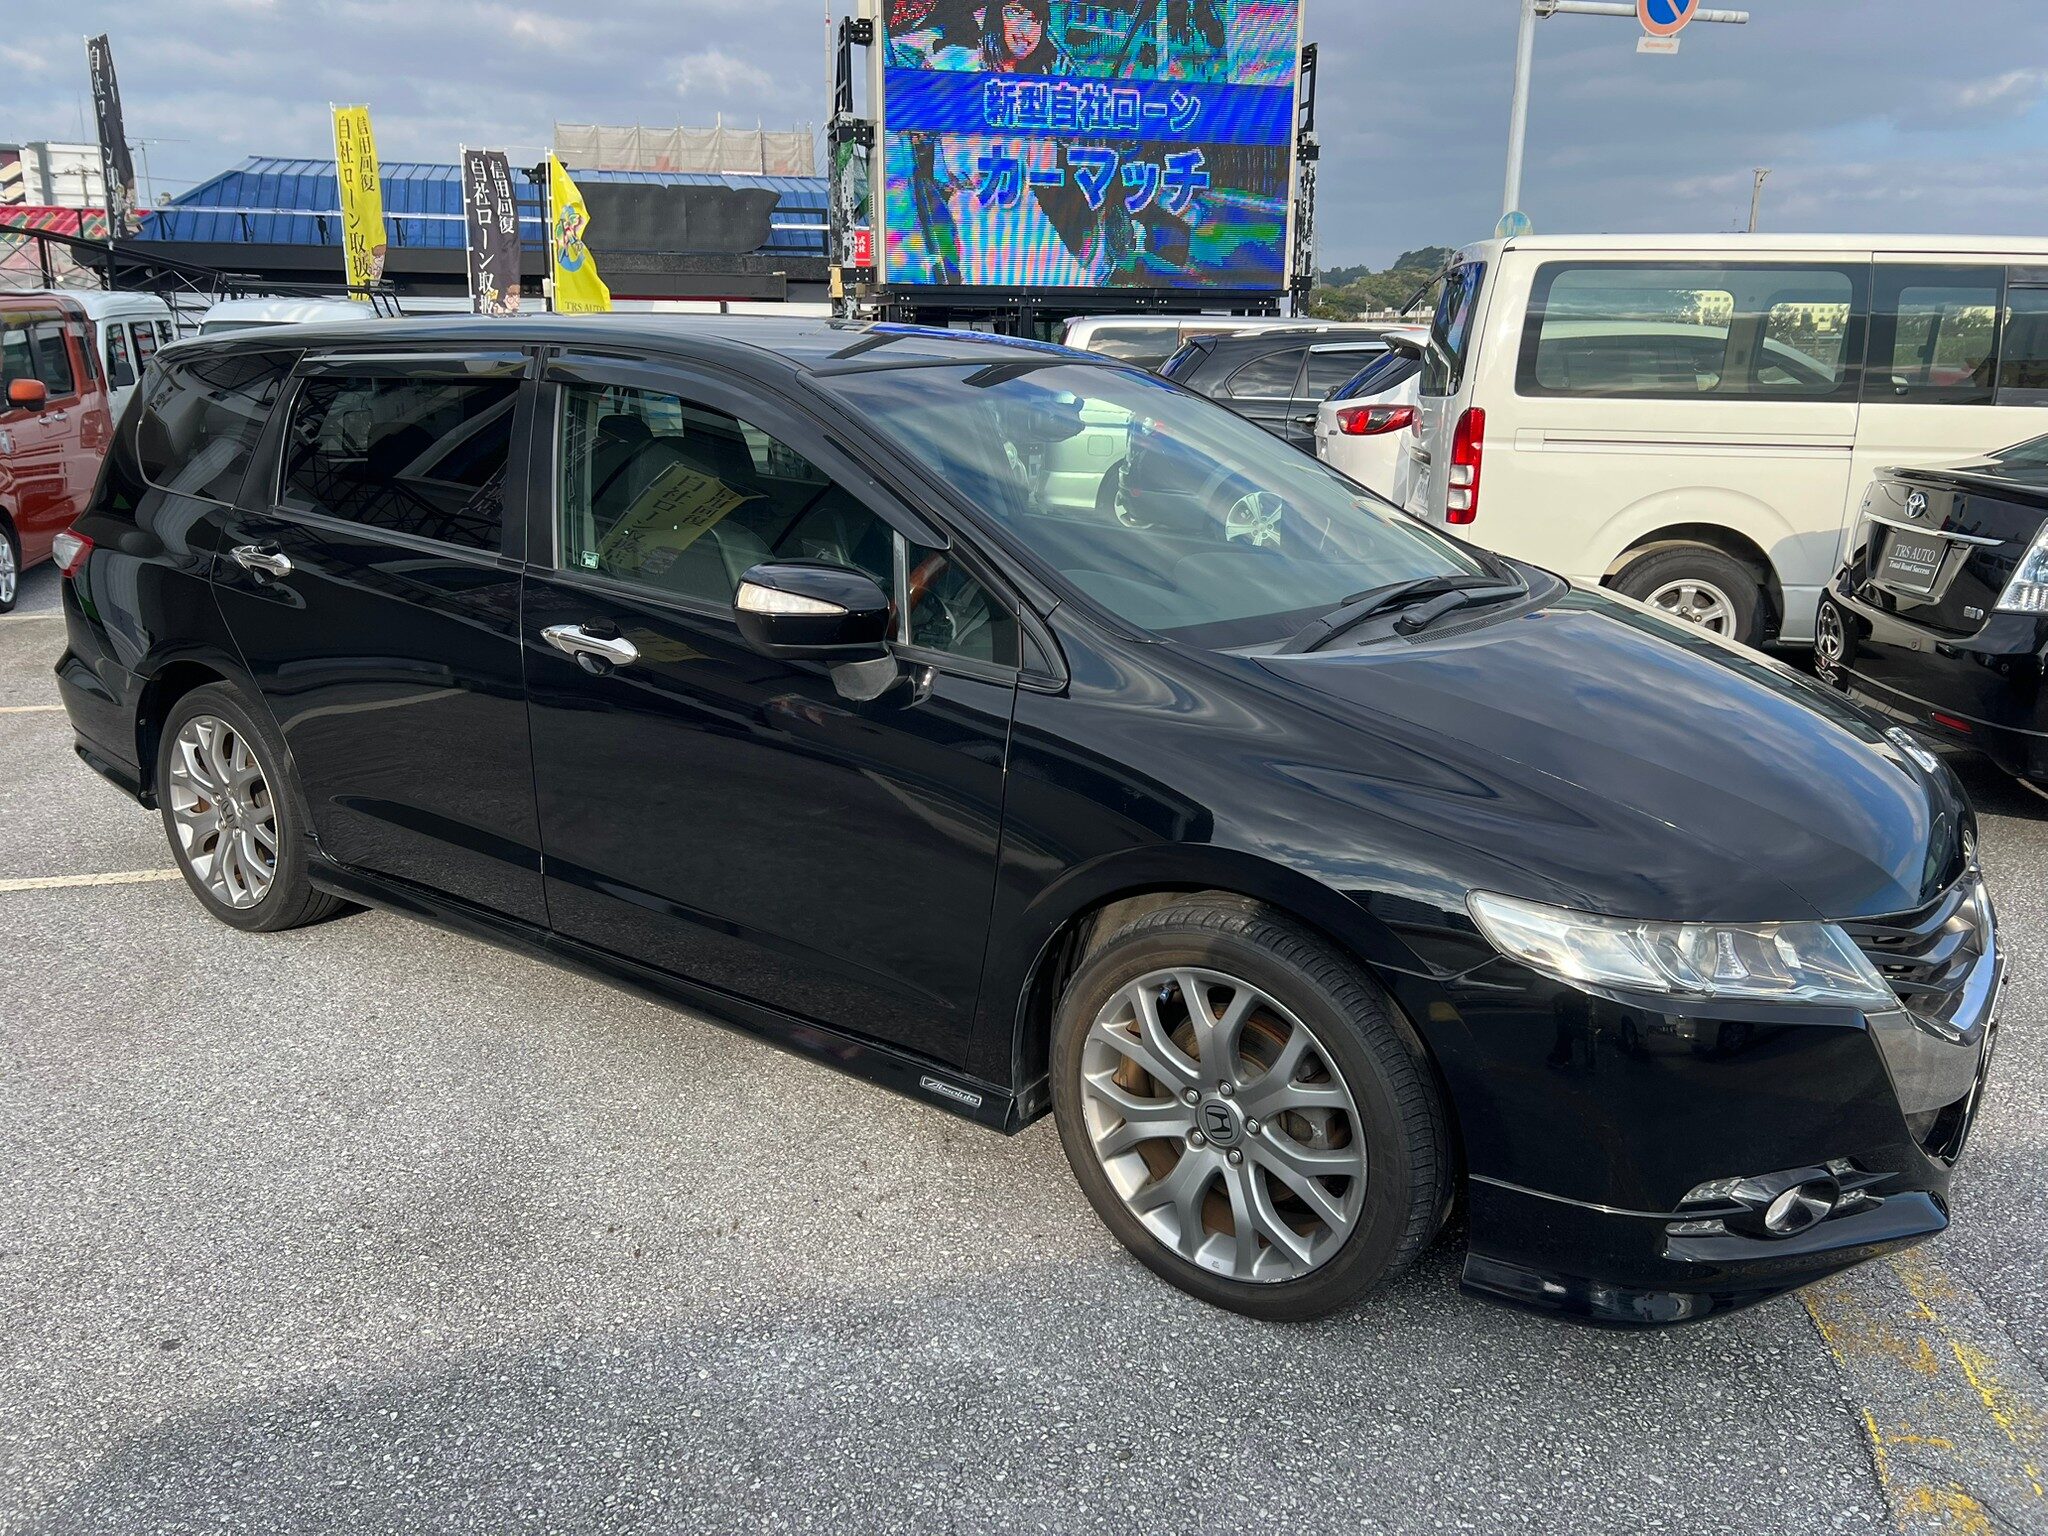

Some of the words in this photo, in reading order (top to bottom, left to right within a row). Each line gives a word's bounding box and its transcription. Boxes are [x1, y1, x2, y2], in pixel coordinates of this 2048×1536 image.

[984, 79, 1201, 132] 新型自社ローン
[357, 116, 375, 192] 信用回復
[976, 143, 1210, 215] カーマッチ
[490, 160, 515, 234] 信用回復
[565, 301, 582, 312] TRS
[1889, 560, 1901, 570] Total
[1912, 565, 1930, 575] Success
[1895, 544, 1912, 558] TRS
[1910, 547, 1936, 563] AUTO
